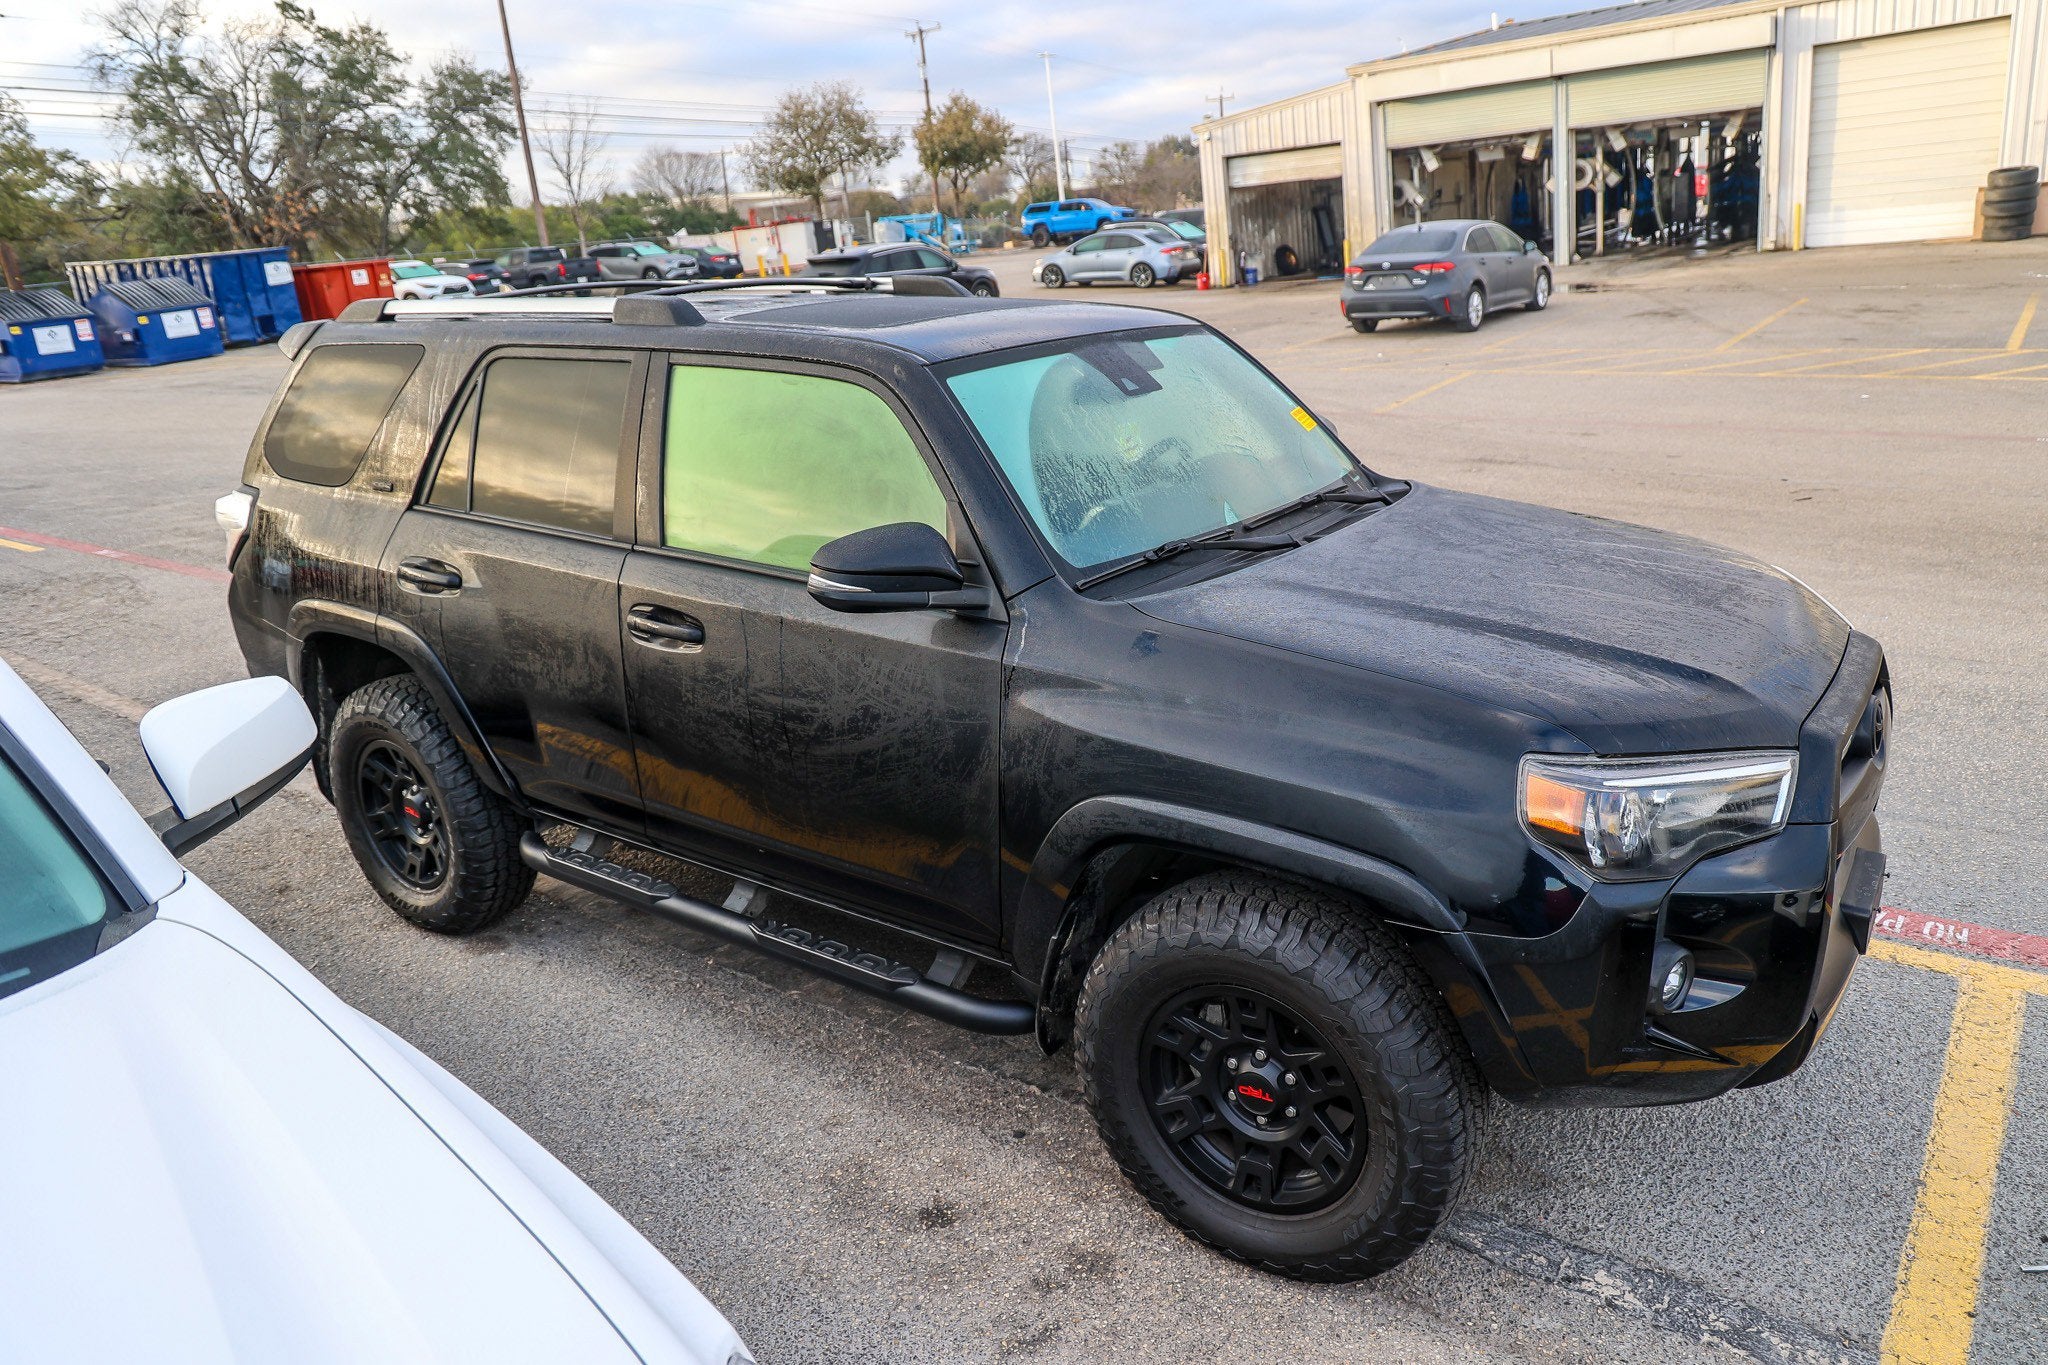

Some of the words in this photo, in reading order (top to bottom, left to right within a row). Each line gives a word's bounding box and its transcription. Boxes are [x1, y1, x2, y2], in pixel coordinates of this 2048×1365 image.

[1923, 920, 1970, 945] NO
[1238, 1085, 1274, 1102] TRD
[1343, 1097, 1399, 1244] TERRAIN
